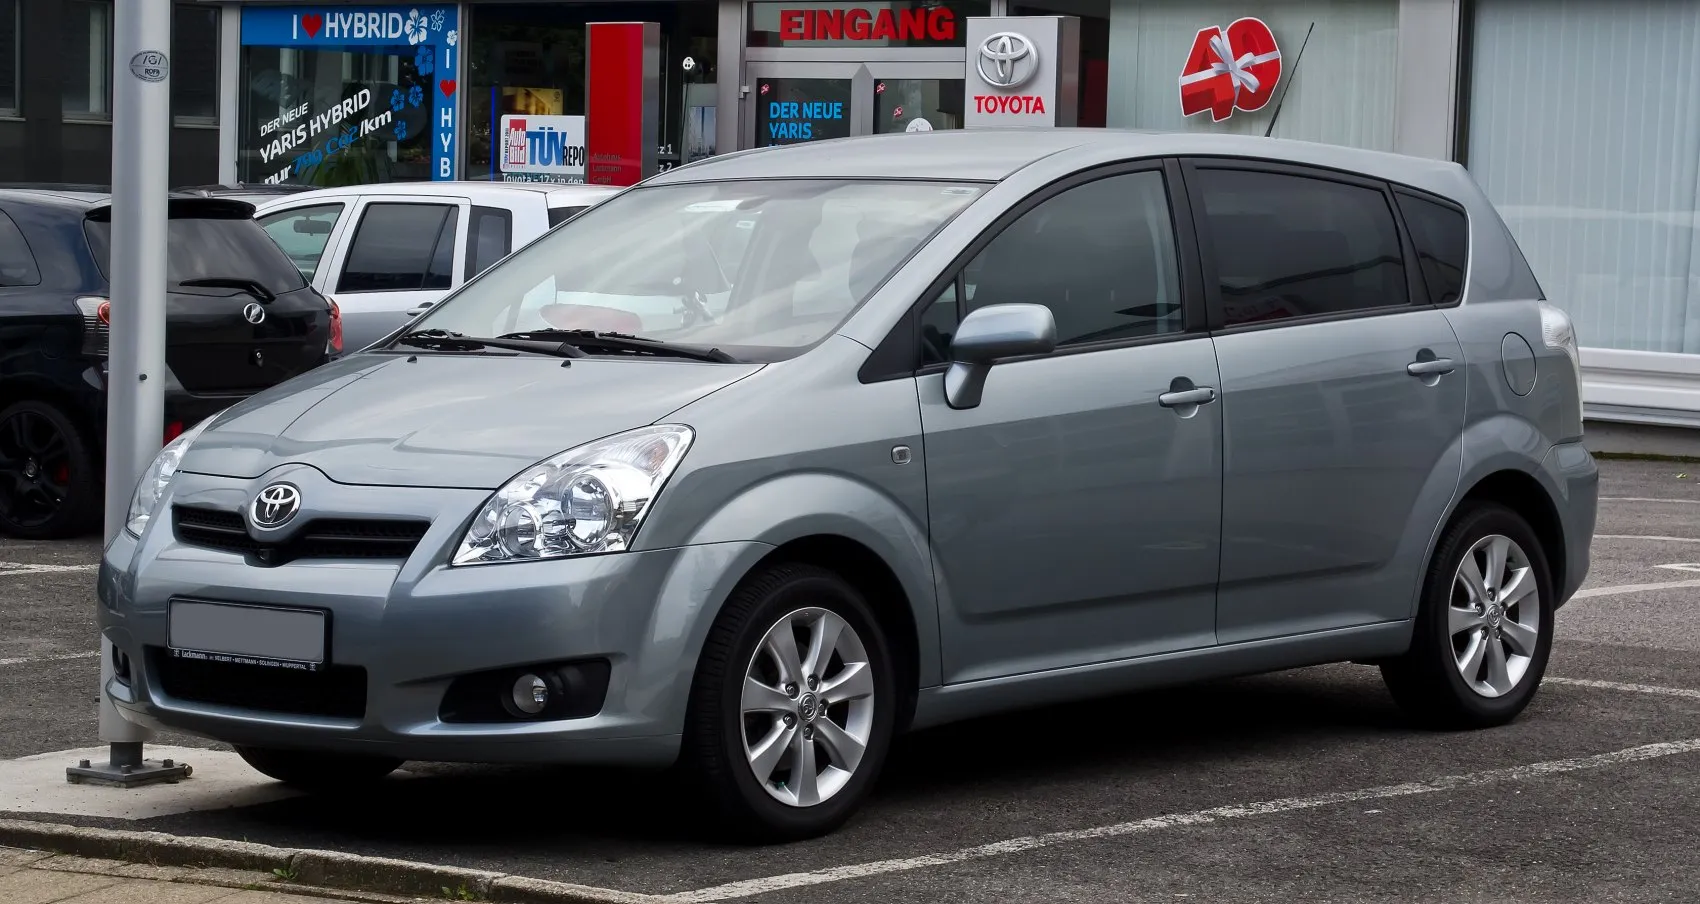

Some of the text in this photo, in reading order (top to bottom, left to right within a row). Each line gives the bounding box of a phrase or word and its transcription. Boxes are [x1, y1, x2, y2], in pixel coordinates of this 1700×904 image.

[292, 12, 403, 39] I HYBRID
[780, 8, 955, 41] EINGANG
[445, 48, 450, 69] I
[769, 101, 843, 119] DER NEUE
[973, 95, 1045, 114] TOYOTA
[259, 88, 371, 164] YARIS HYBRID
[260, 102, 309, 138] DER NEUE
[768, 122, 812, 140] YARIS
[526, 127, 567, 166] TÜV
[667, 143, 673, 155] 1
[264, 165, 292, 184] nur
